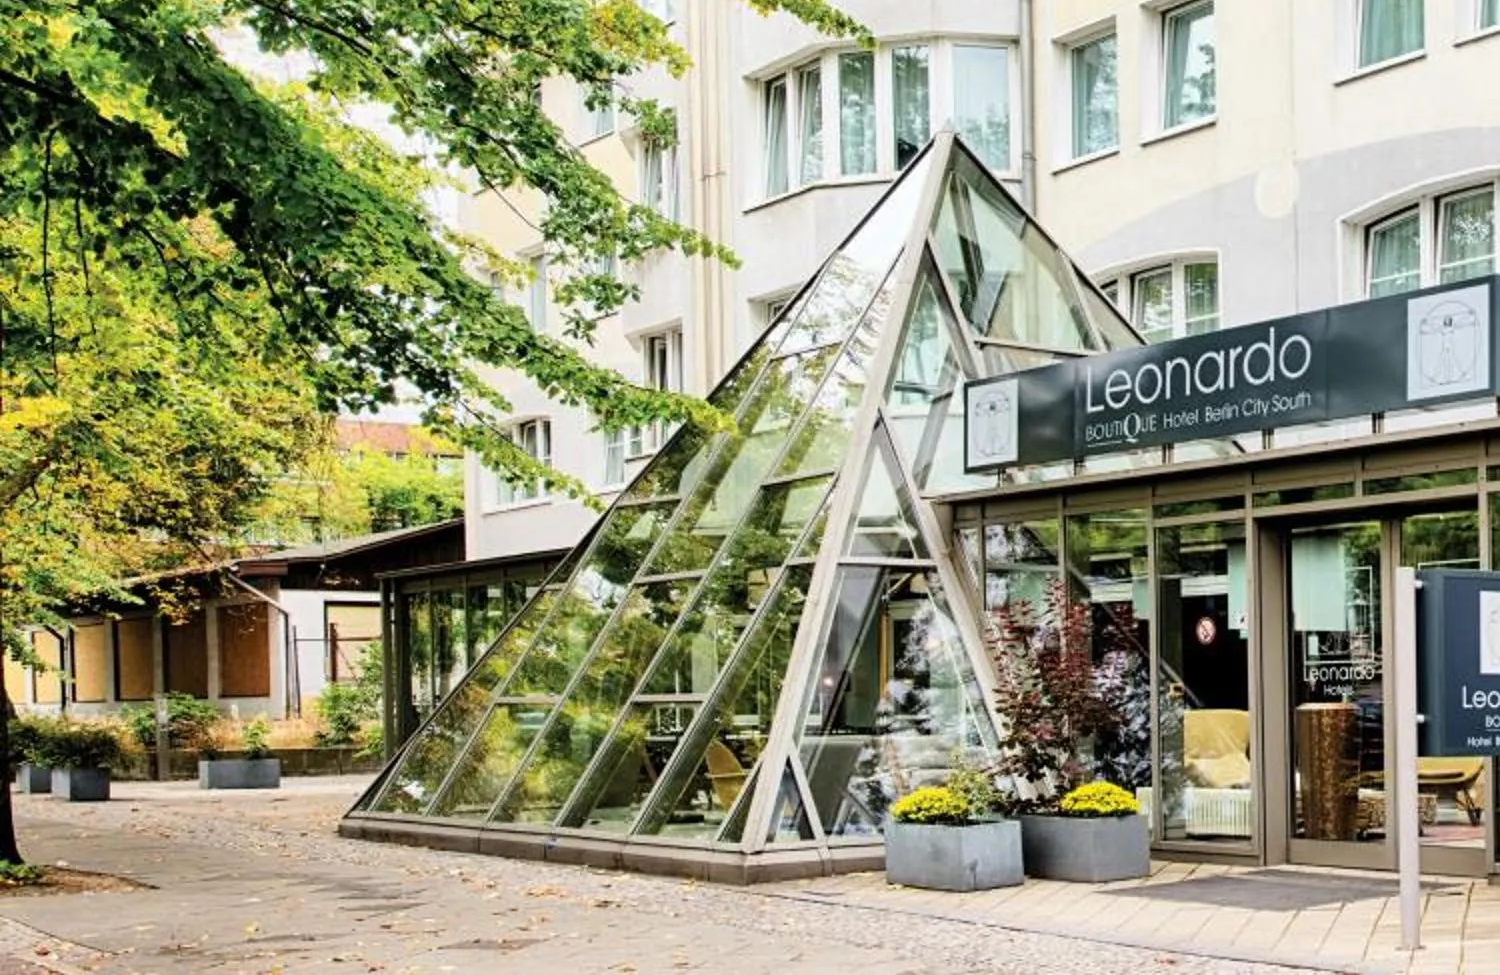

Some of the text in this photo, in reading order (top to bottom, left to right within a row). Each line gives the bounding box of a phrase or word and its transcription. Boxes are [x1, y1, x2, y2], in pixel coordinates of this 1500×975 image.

[1086, 327, 1312, 413] Leonardo
[1085, 391, 1312, 444] BOUTIQUE Hotel Berlin City South
[1303, 663, 1375, 682] Leonardo
[1466, 736, 1492, 747] Hotel
